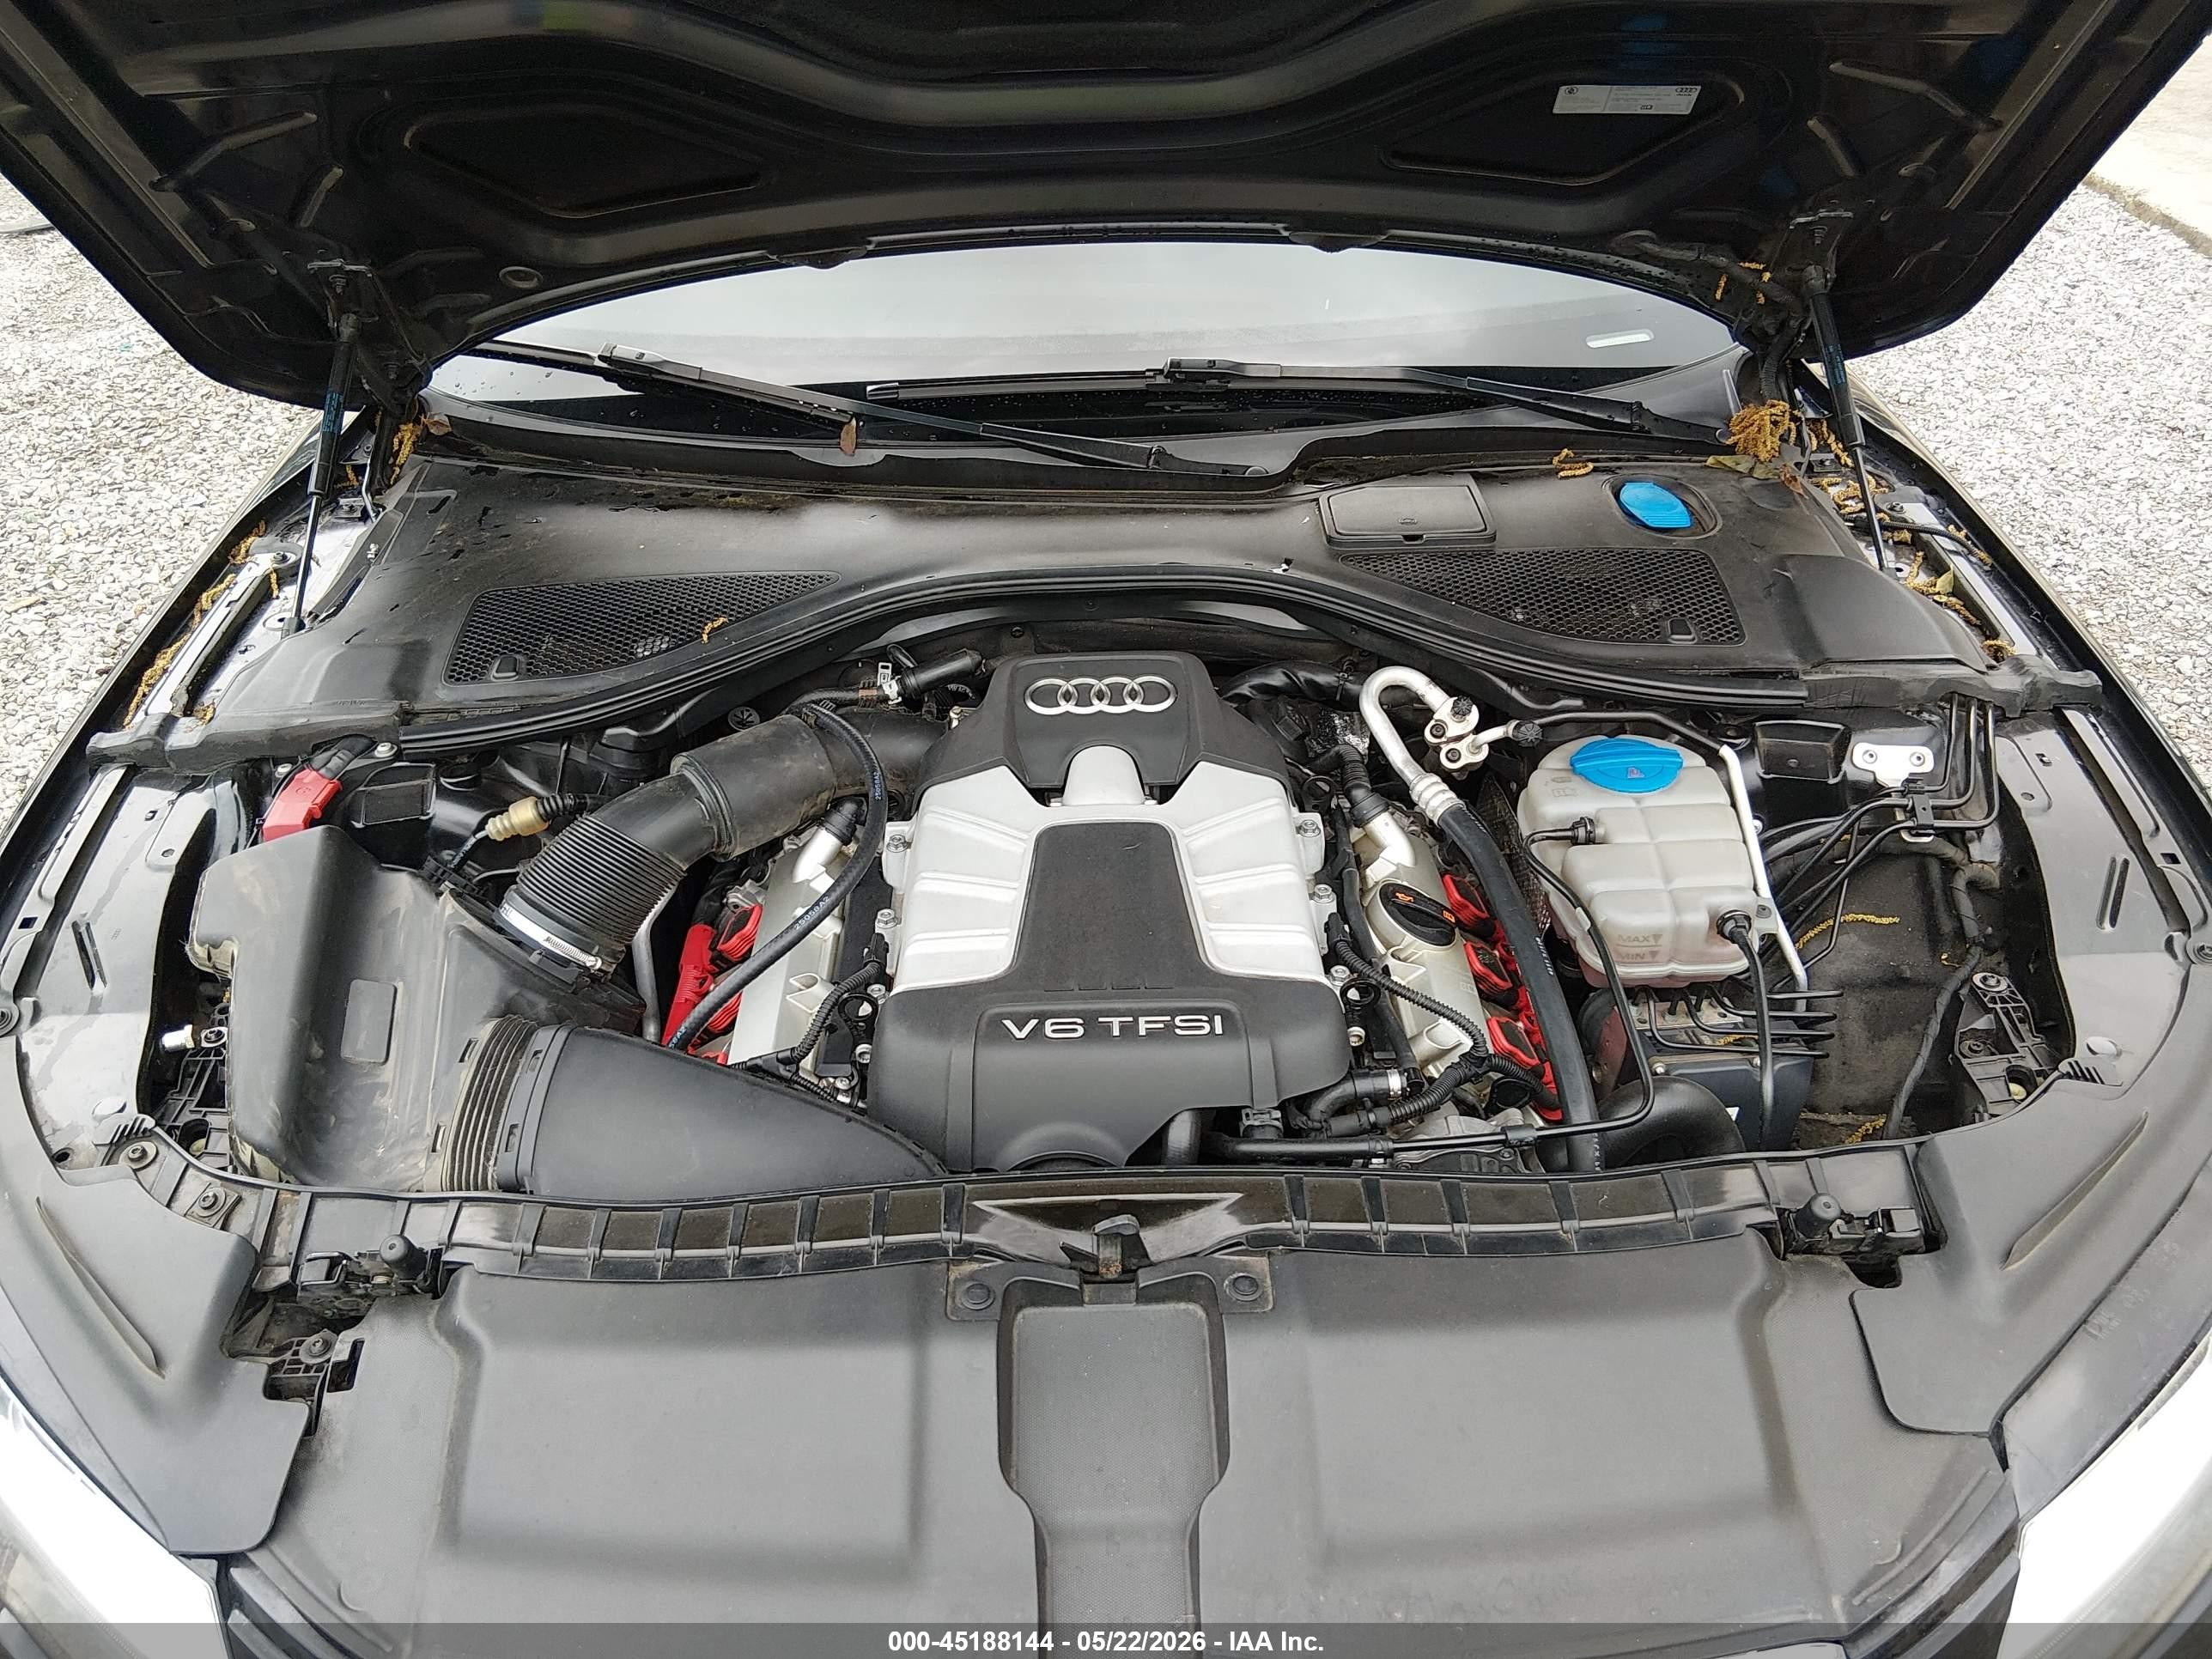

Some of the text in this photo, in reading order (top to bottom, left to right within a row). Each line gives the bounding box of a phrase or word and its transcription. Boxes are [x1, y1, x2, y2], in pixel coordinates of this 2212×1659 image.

[1617, 934, 1650, 943] MAX
[1618, 952, 1646, 961] MIN
[1001, 1014, 1224, 1041] V6 TFSI
